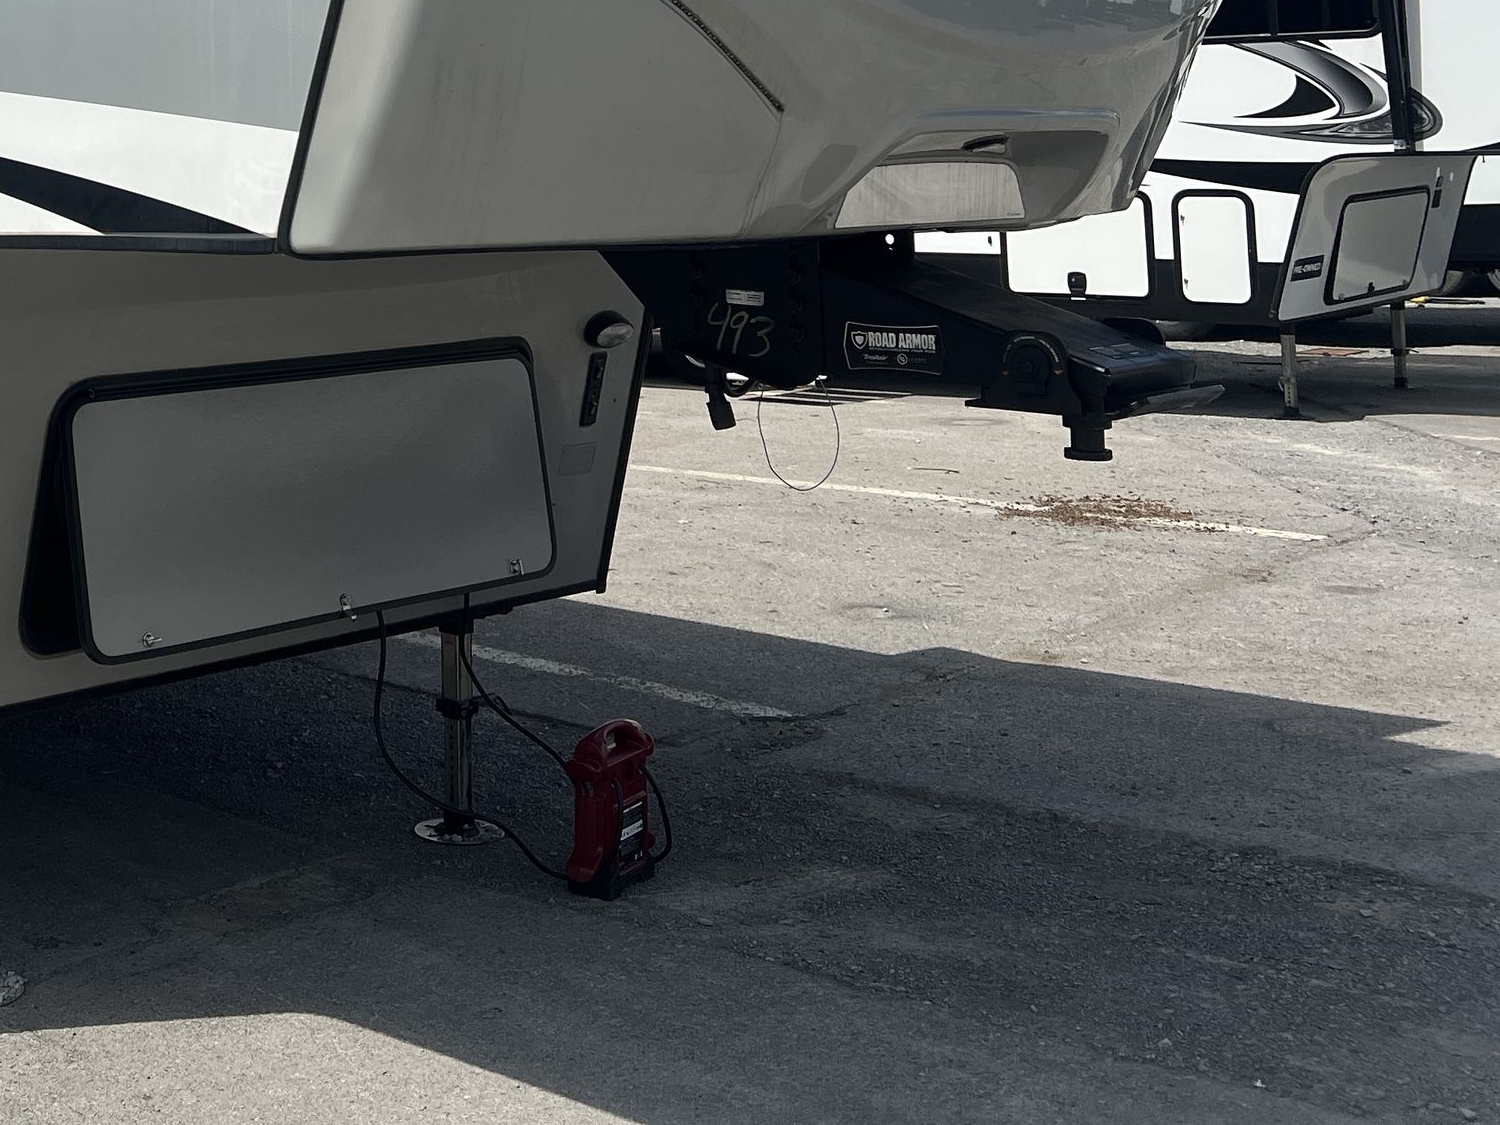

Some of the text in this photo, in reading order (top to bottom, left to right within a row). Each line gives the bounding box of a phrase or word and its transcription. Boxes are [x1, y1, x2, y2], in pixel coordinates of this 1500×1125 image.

[708, 302, 775, 357] 493
[867, 331, 936, 350] ROAD ARMOR
